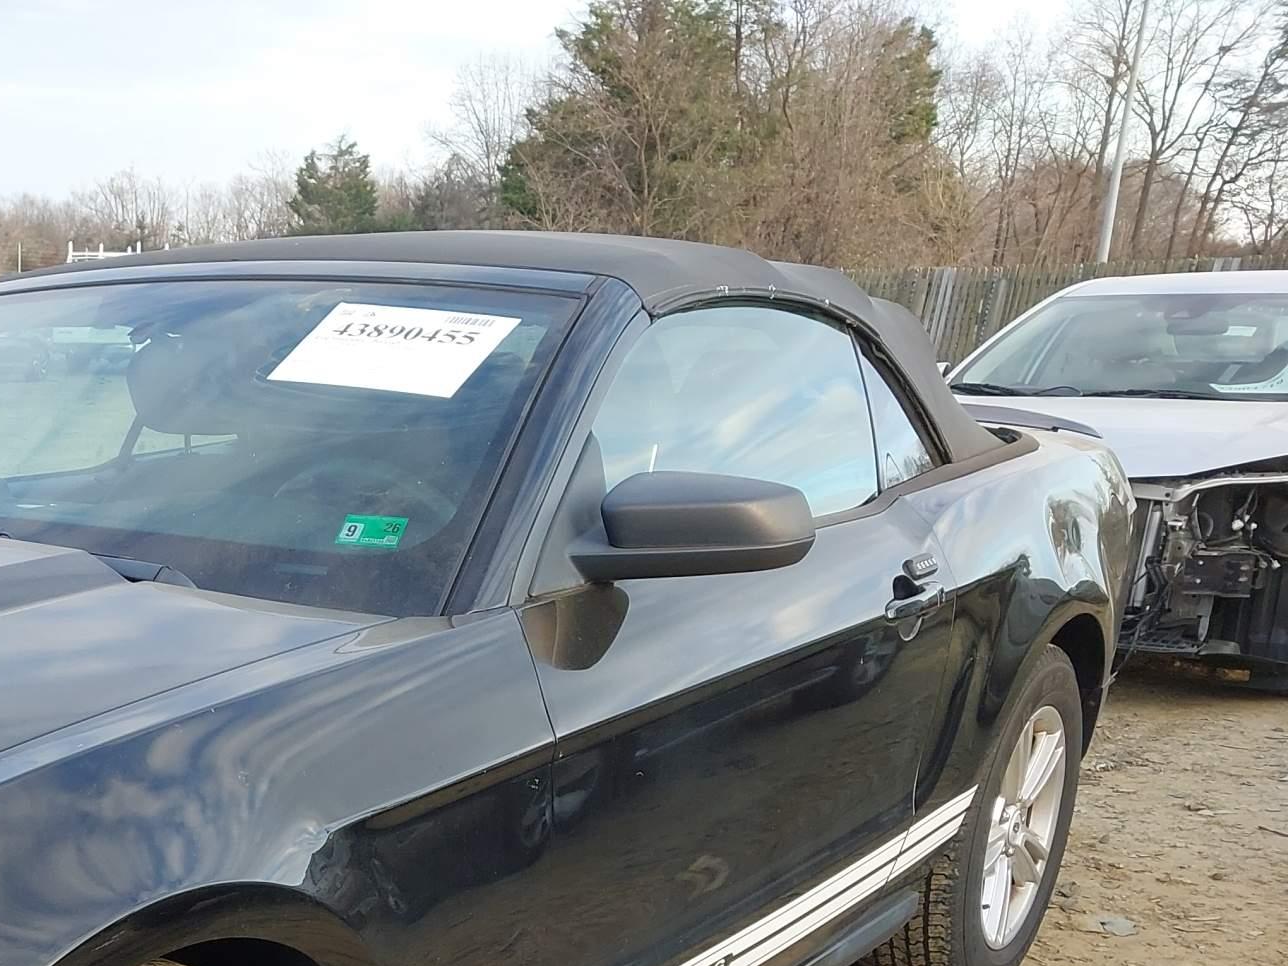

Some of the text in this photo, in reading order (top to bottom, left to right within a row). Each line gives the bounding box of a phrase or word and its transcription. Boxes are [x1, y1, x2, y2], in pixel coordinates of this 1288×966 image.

[332, 322, 480, 345] 43890455
[345, 524, 358, 537] 9
[383, 523, 402, 534] 26
